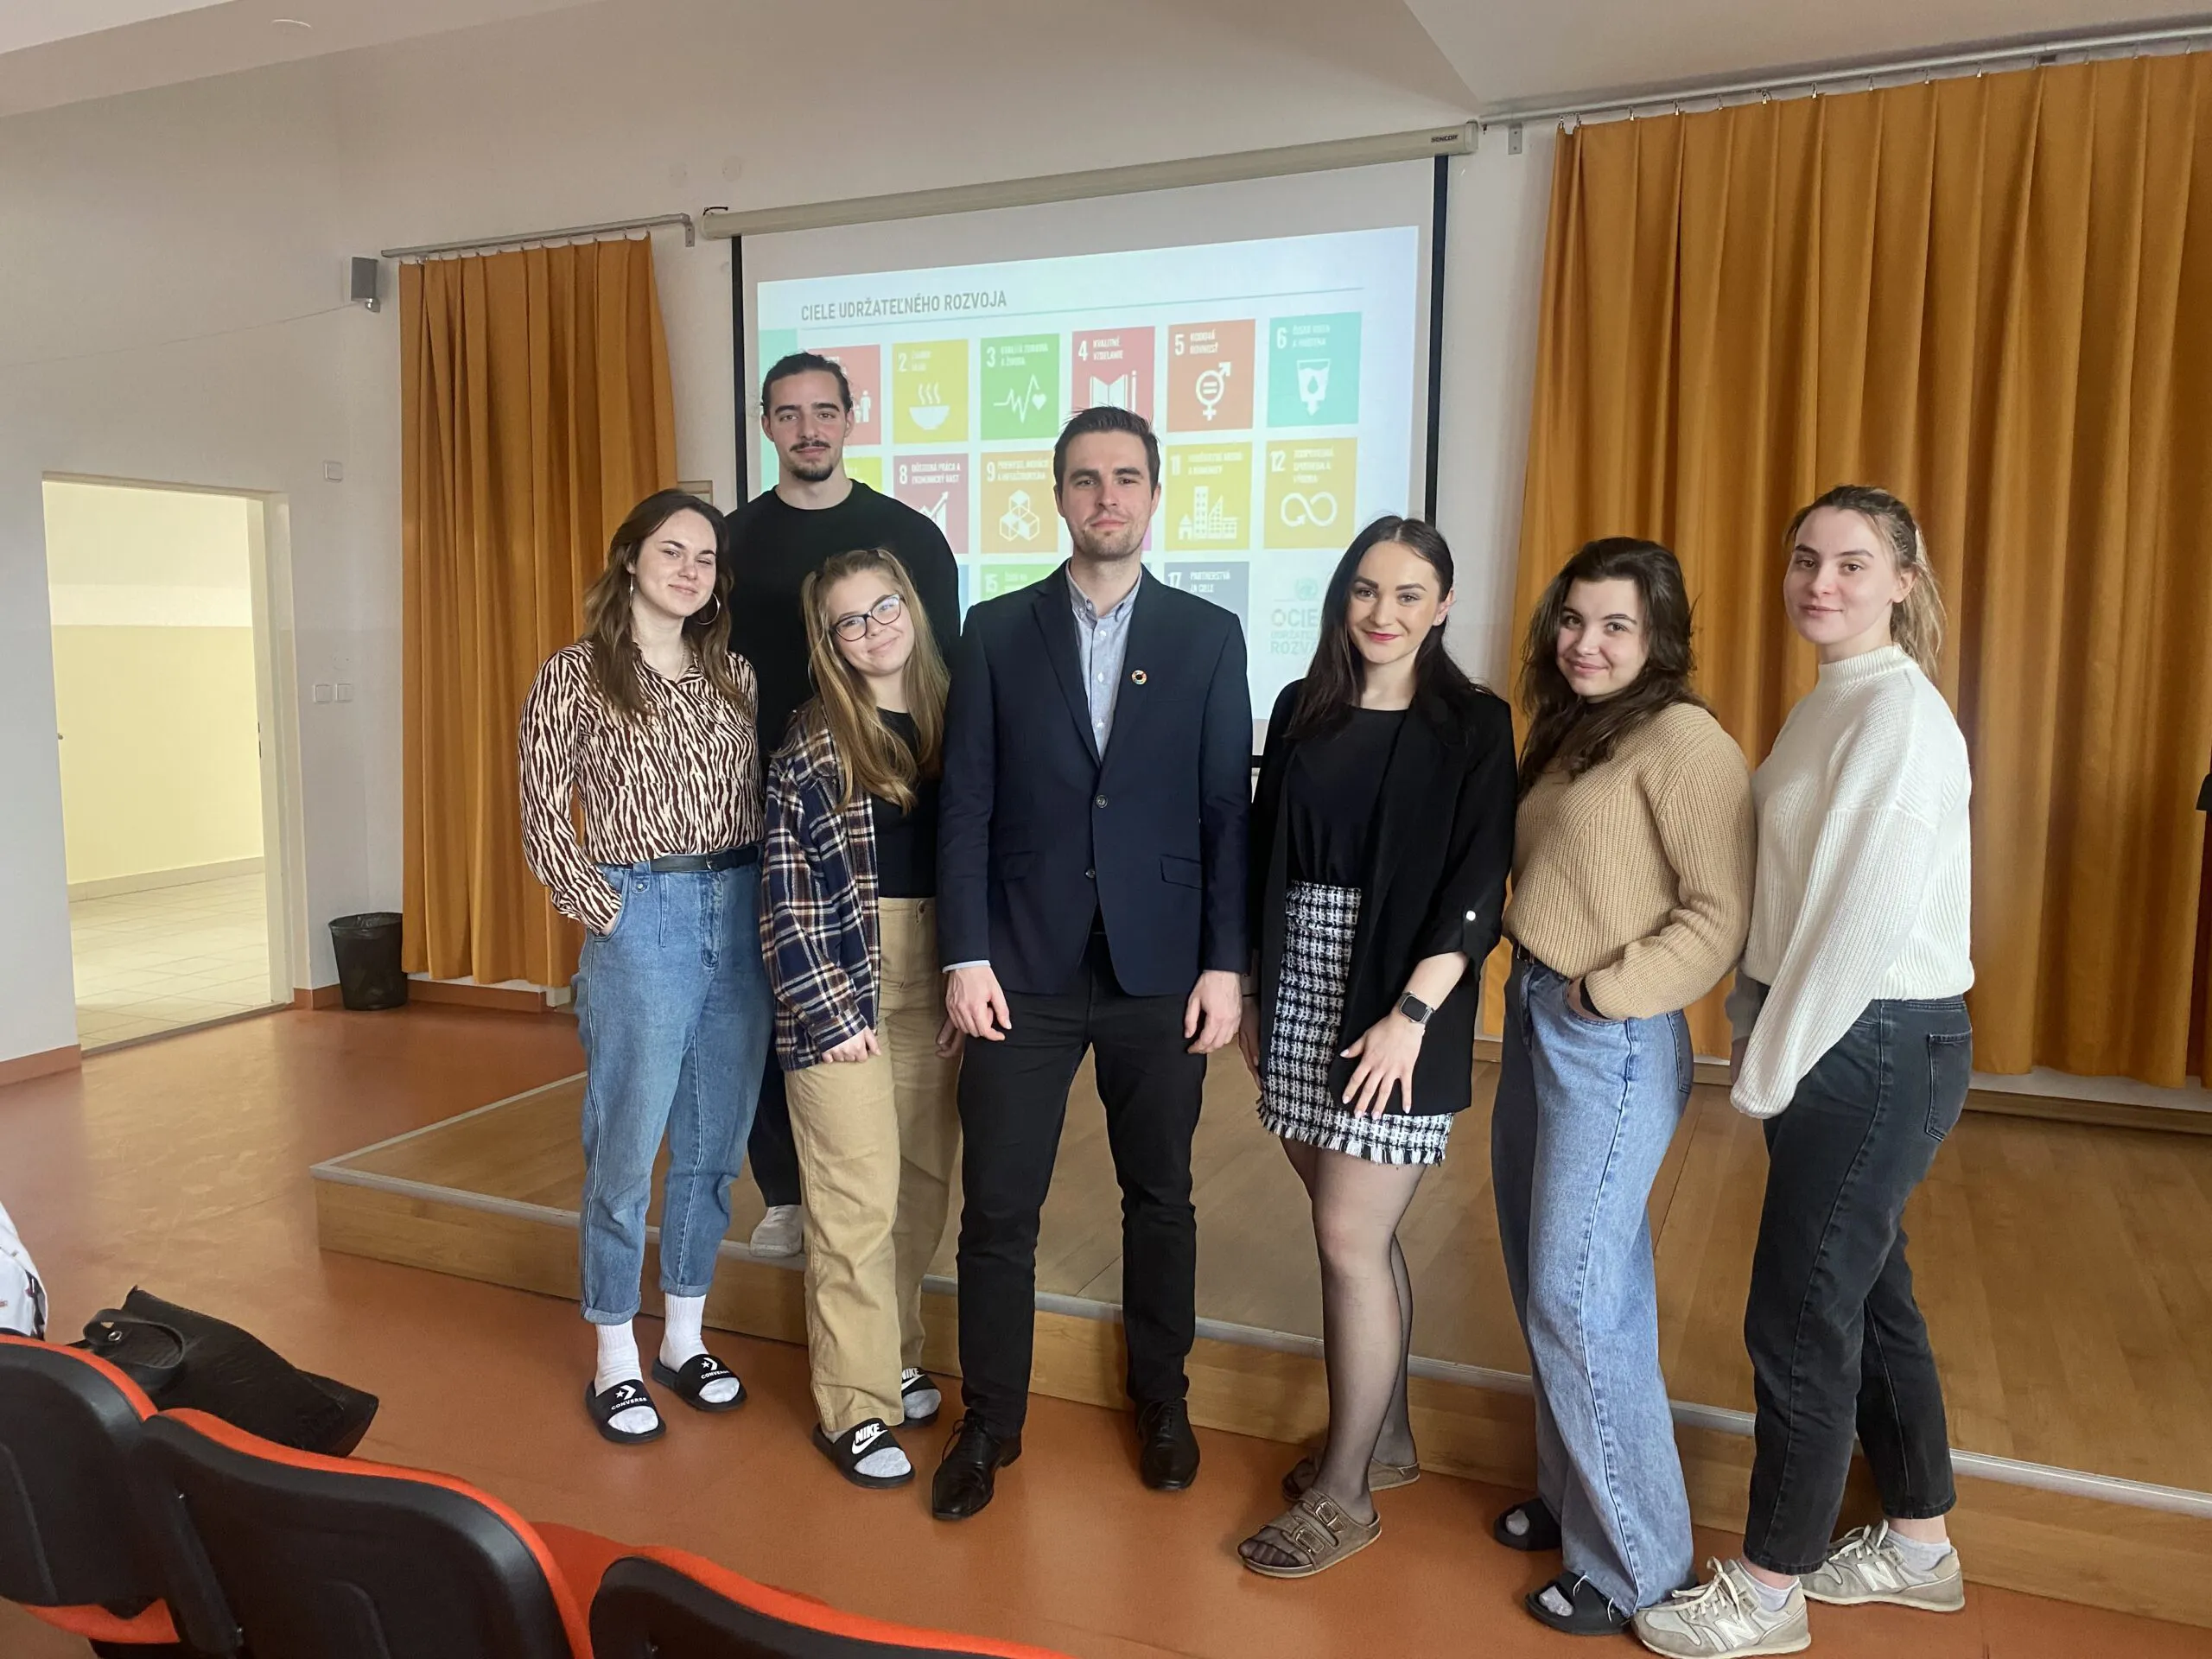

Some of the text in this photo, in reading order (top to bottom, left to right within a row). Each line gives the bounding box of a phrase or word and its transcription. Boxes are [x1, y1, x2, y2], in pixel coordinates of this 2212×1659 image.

[801, 290, 1007, 321] CIELE UDRŽATEĽNÉHO ROZVOJA
[1174, 334, 1185, 356] 5
[1277, 327, 1287, 349] 6
[986, 346, 996, 368] 3
[1077, 340, 1089, 361] 4
[897, 352, 907, 372] 2
[986, 461, 995, 482] 9
[1270, 449, 1286, 473] 12
[899, 464, 907, 485] 8
[1168, 571, 1182, 588] 17
[611, 1397, 647, 1410] CONVERSE
[855, 1422, 880, 1445] NIKE
